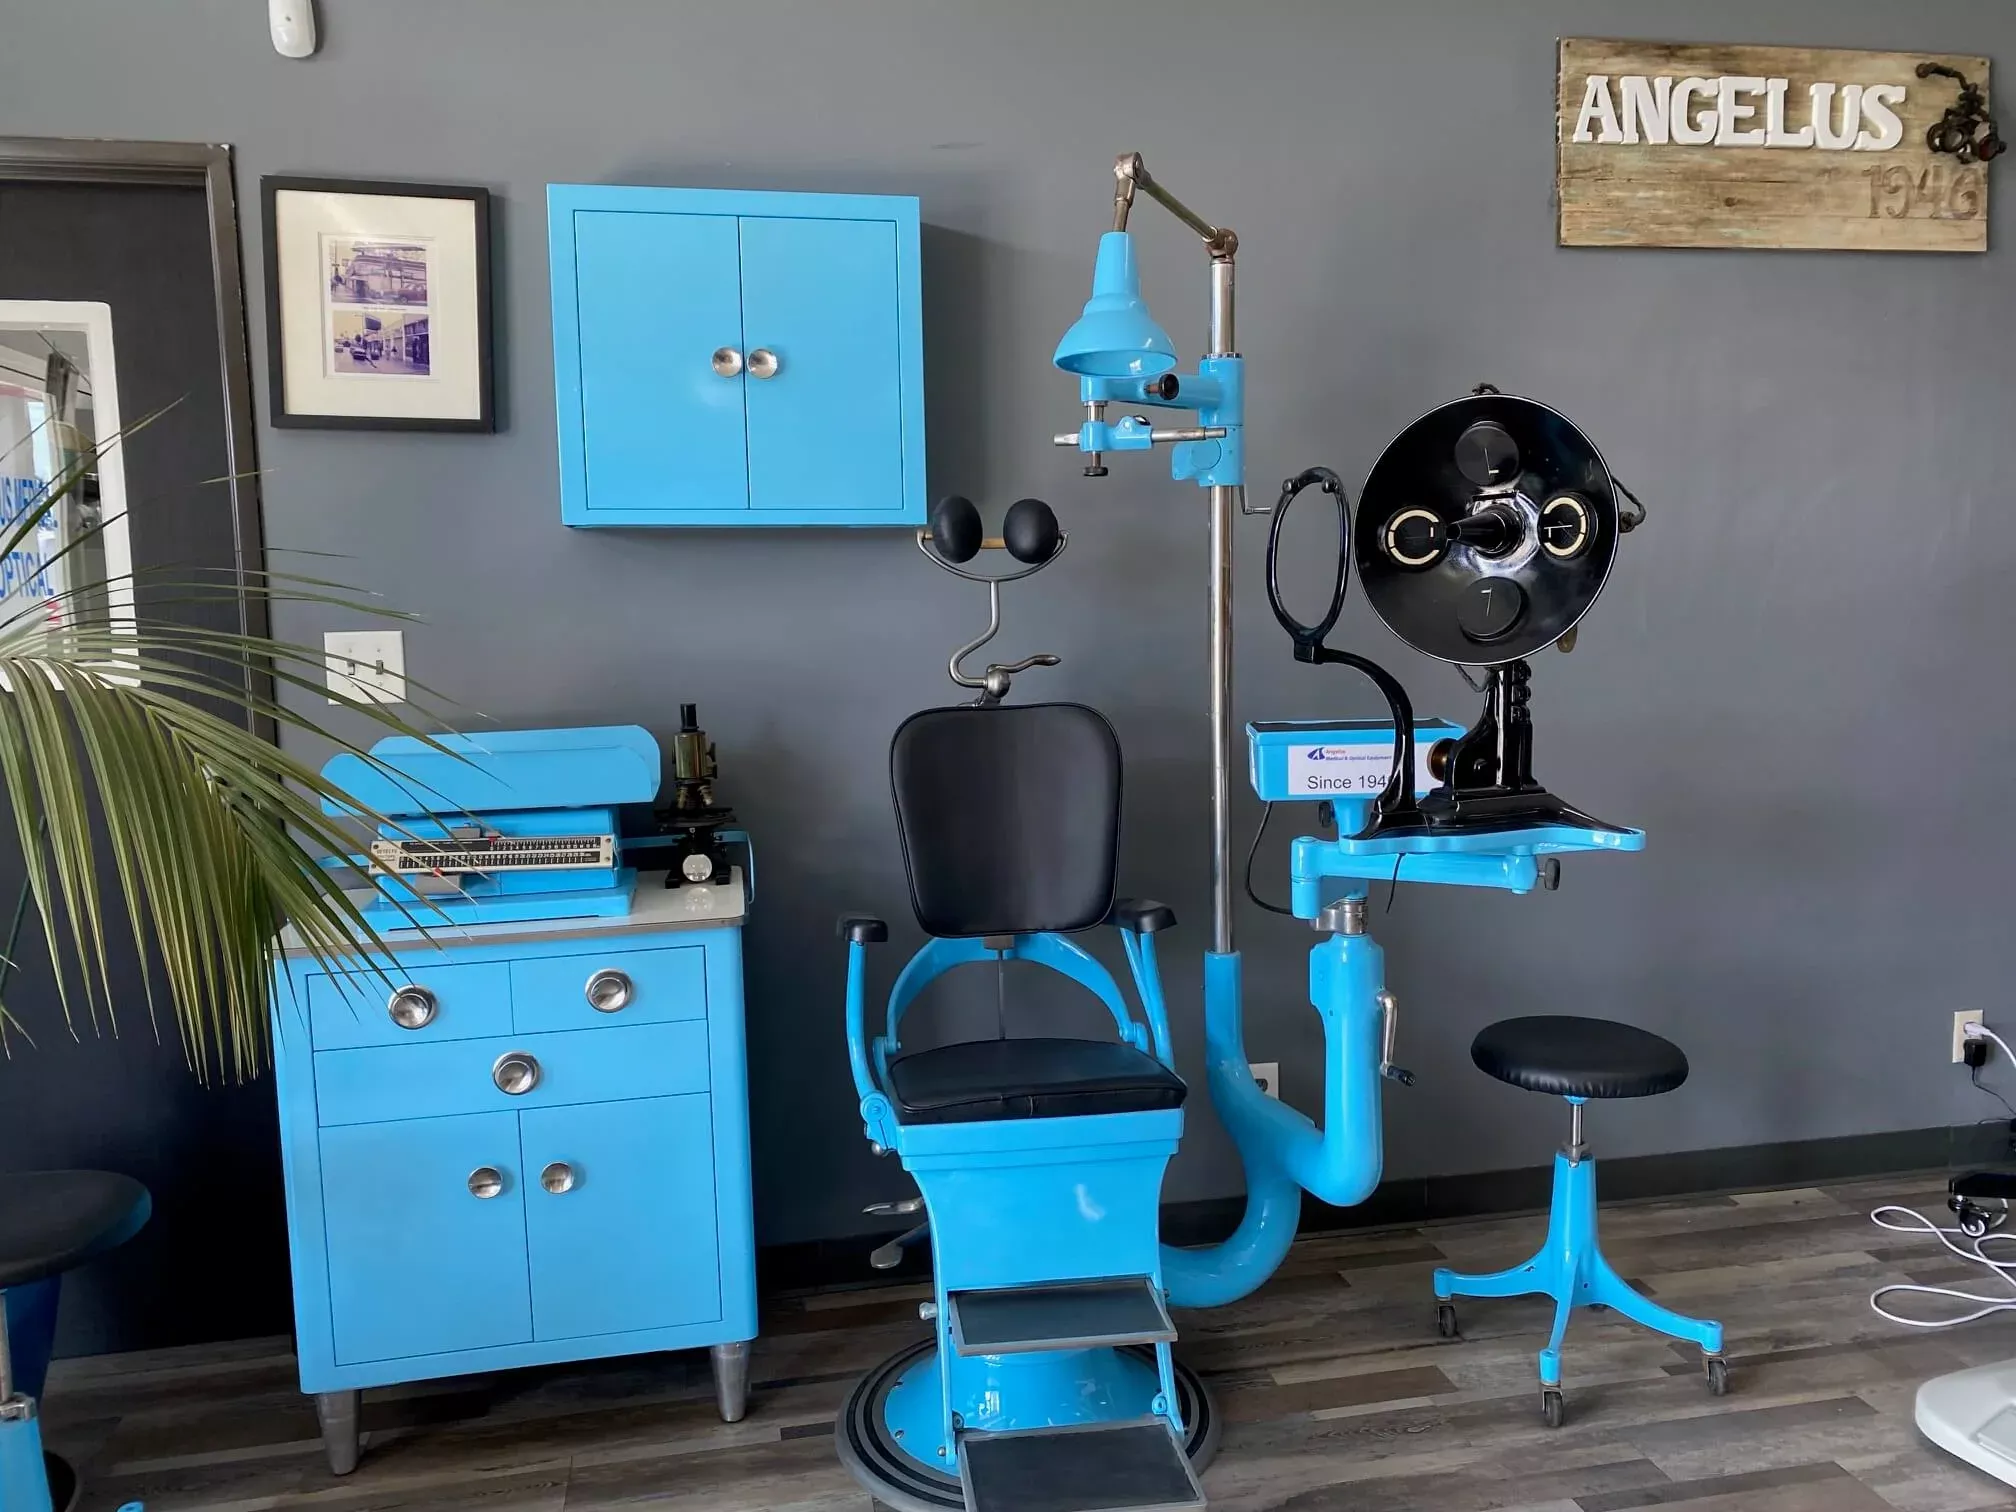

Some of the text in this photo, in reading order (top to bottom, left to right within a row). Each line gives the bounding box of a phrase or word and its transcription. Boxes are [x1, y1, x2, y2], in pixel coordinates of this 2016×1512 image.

[1572, 75, 1907, 152] ANGELUS
[1861, 164, 1979, 219] 1946
[1307, 775, 1391, 790] Since 194
